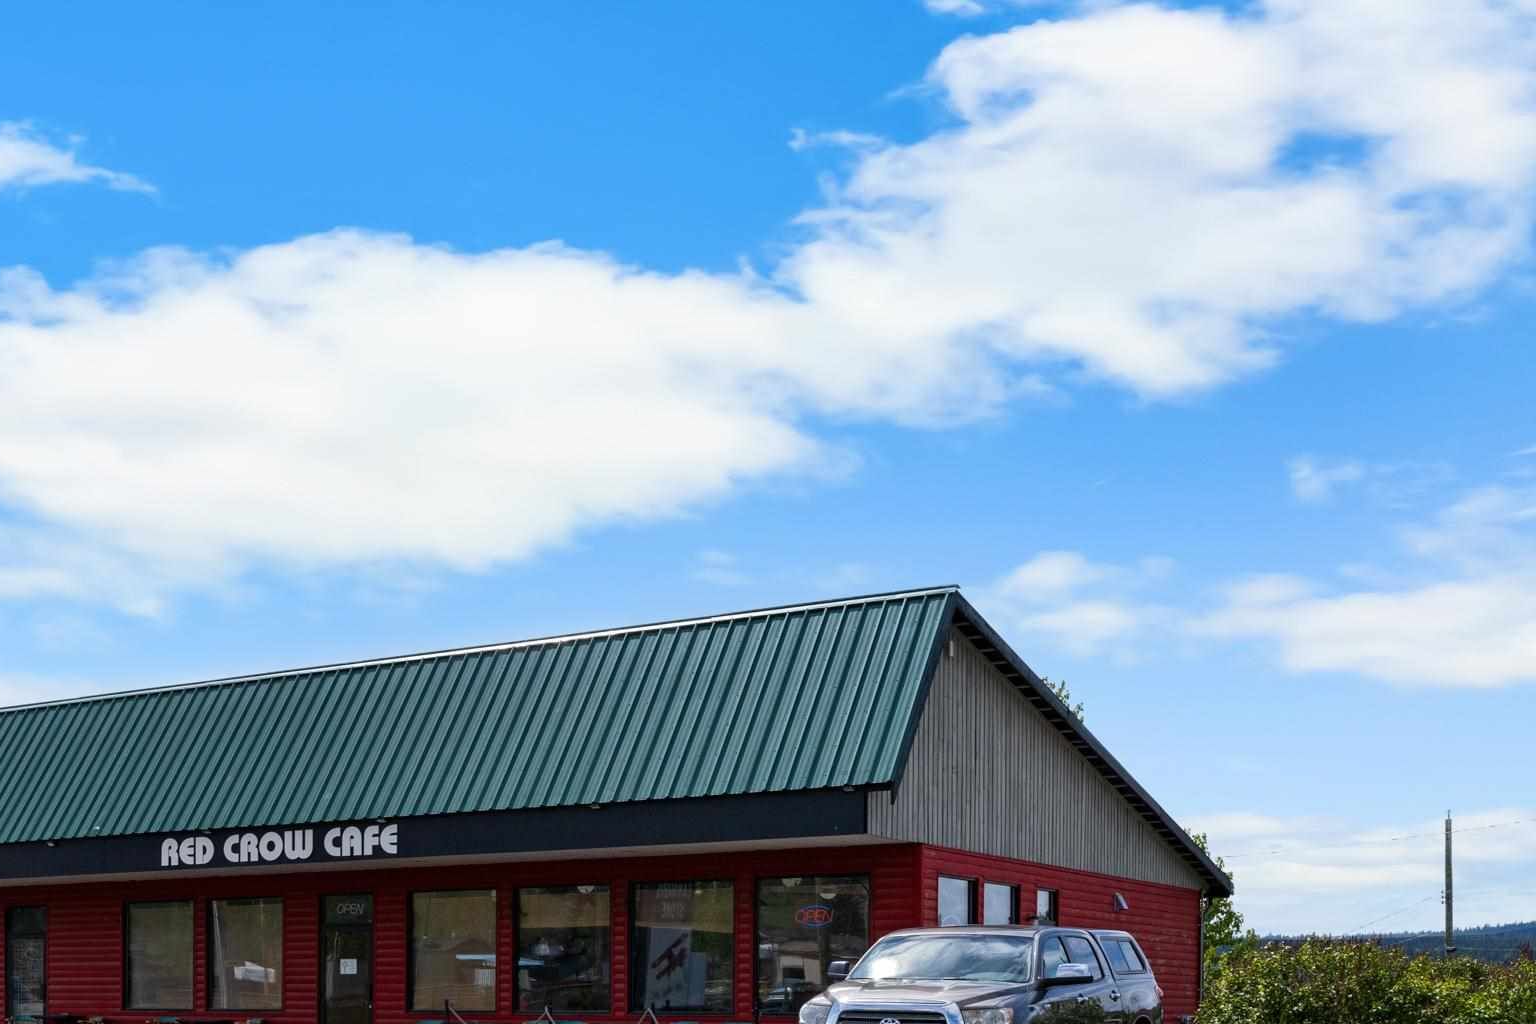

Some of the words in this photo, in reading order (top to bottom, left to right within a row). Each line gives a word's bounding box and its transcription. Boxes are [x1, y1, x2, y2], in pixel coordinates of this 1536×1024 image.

[161, 837, 214, 866] RED
[223, 829, 313, 863] CROW
[324, 824, 398, 857] CAFE
[336, 903, 365, 915] OPEN
[795, 908, 833, 923] OPEN
